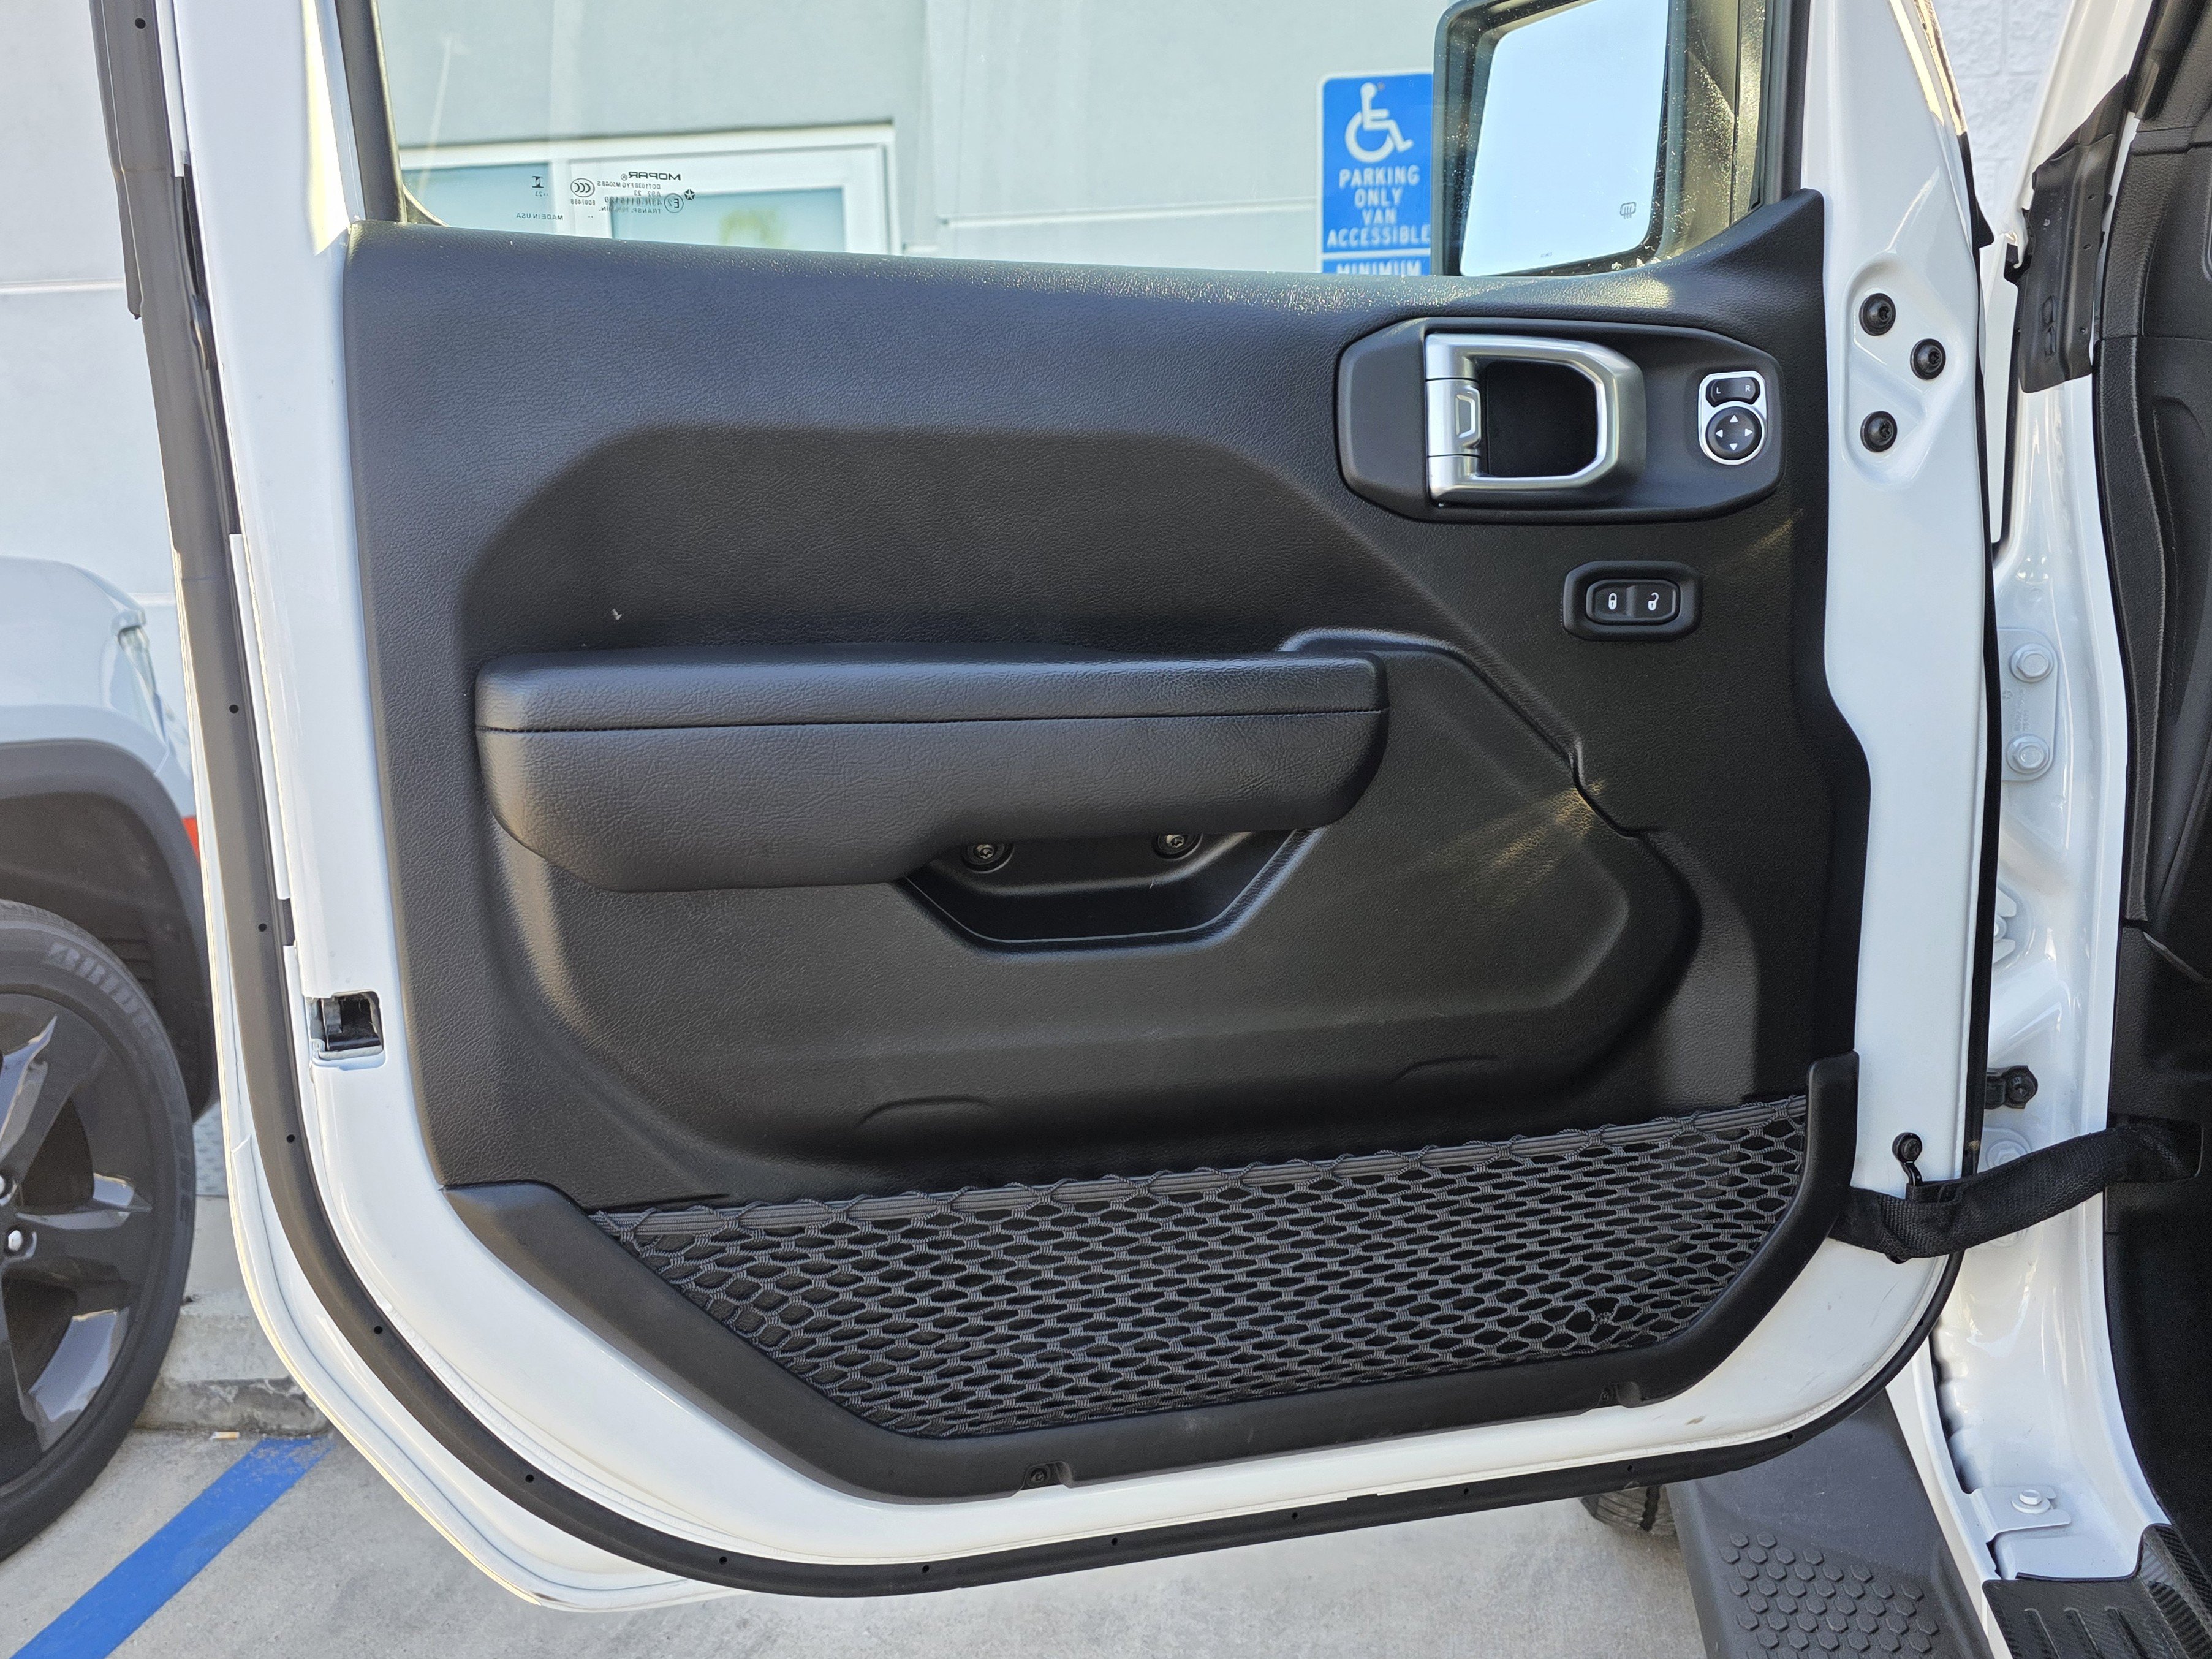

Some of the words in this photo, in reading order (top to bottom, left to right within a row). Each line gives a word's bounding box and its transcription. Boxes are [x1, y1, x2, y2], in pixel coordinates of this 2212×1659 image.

[1339, 165, 1420, 189] PARKING
[1354, 187, 1404, 208] ONLY
[1361, 208, 1397, 226] VAN
[1327, 224, 1430, 248] ACCESSIBLE
